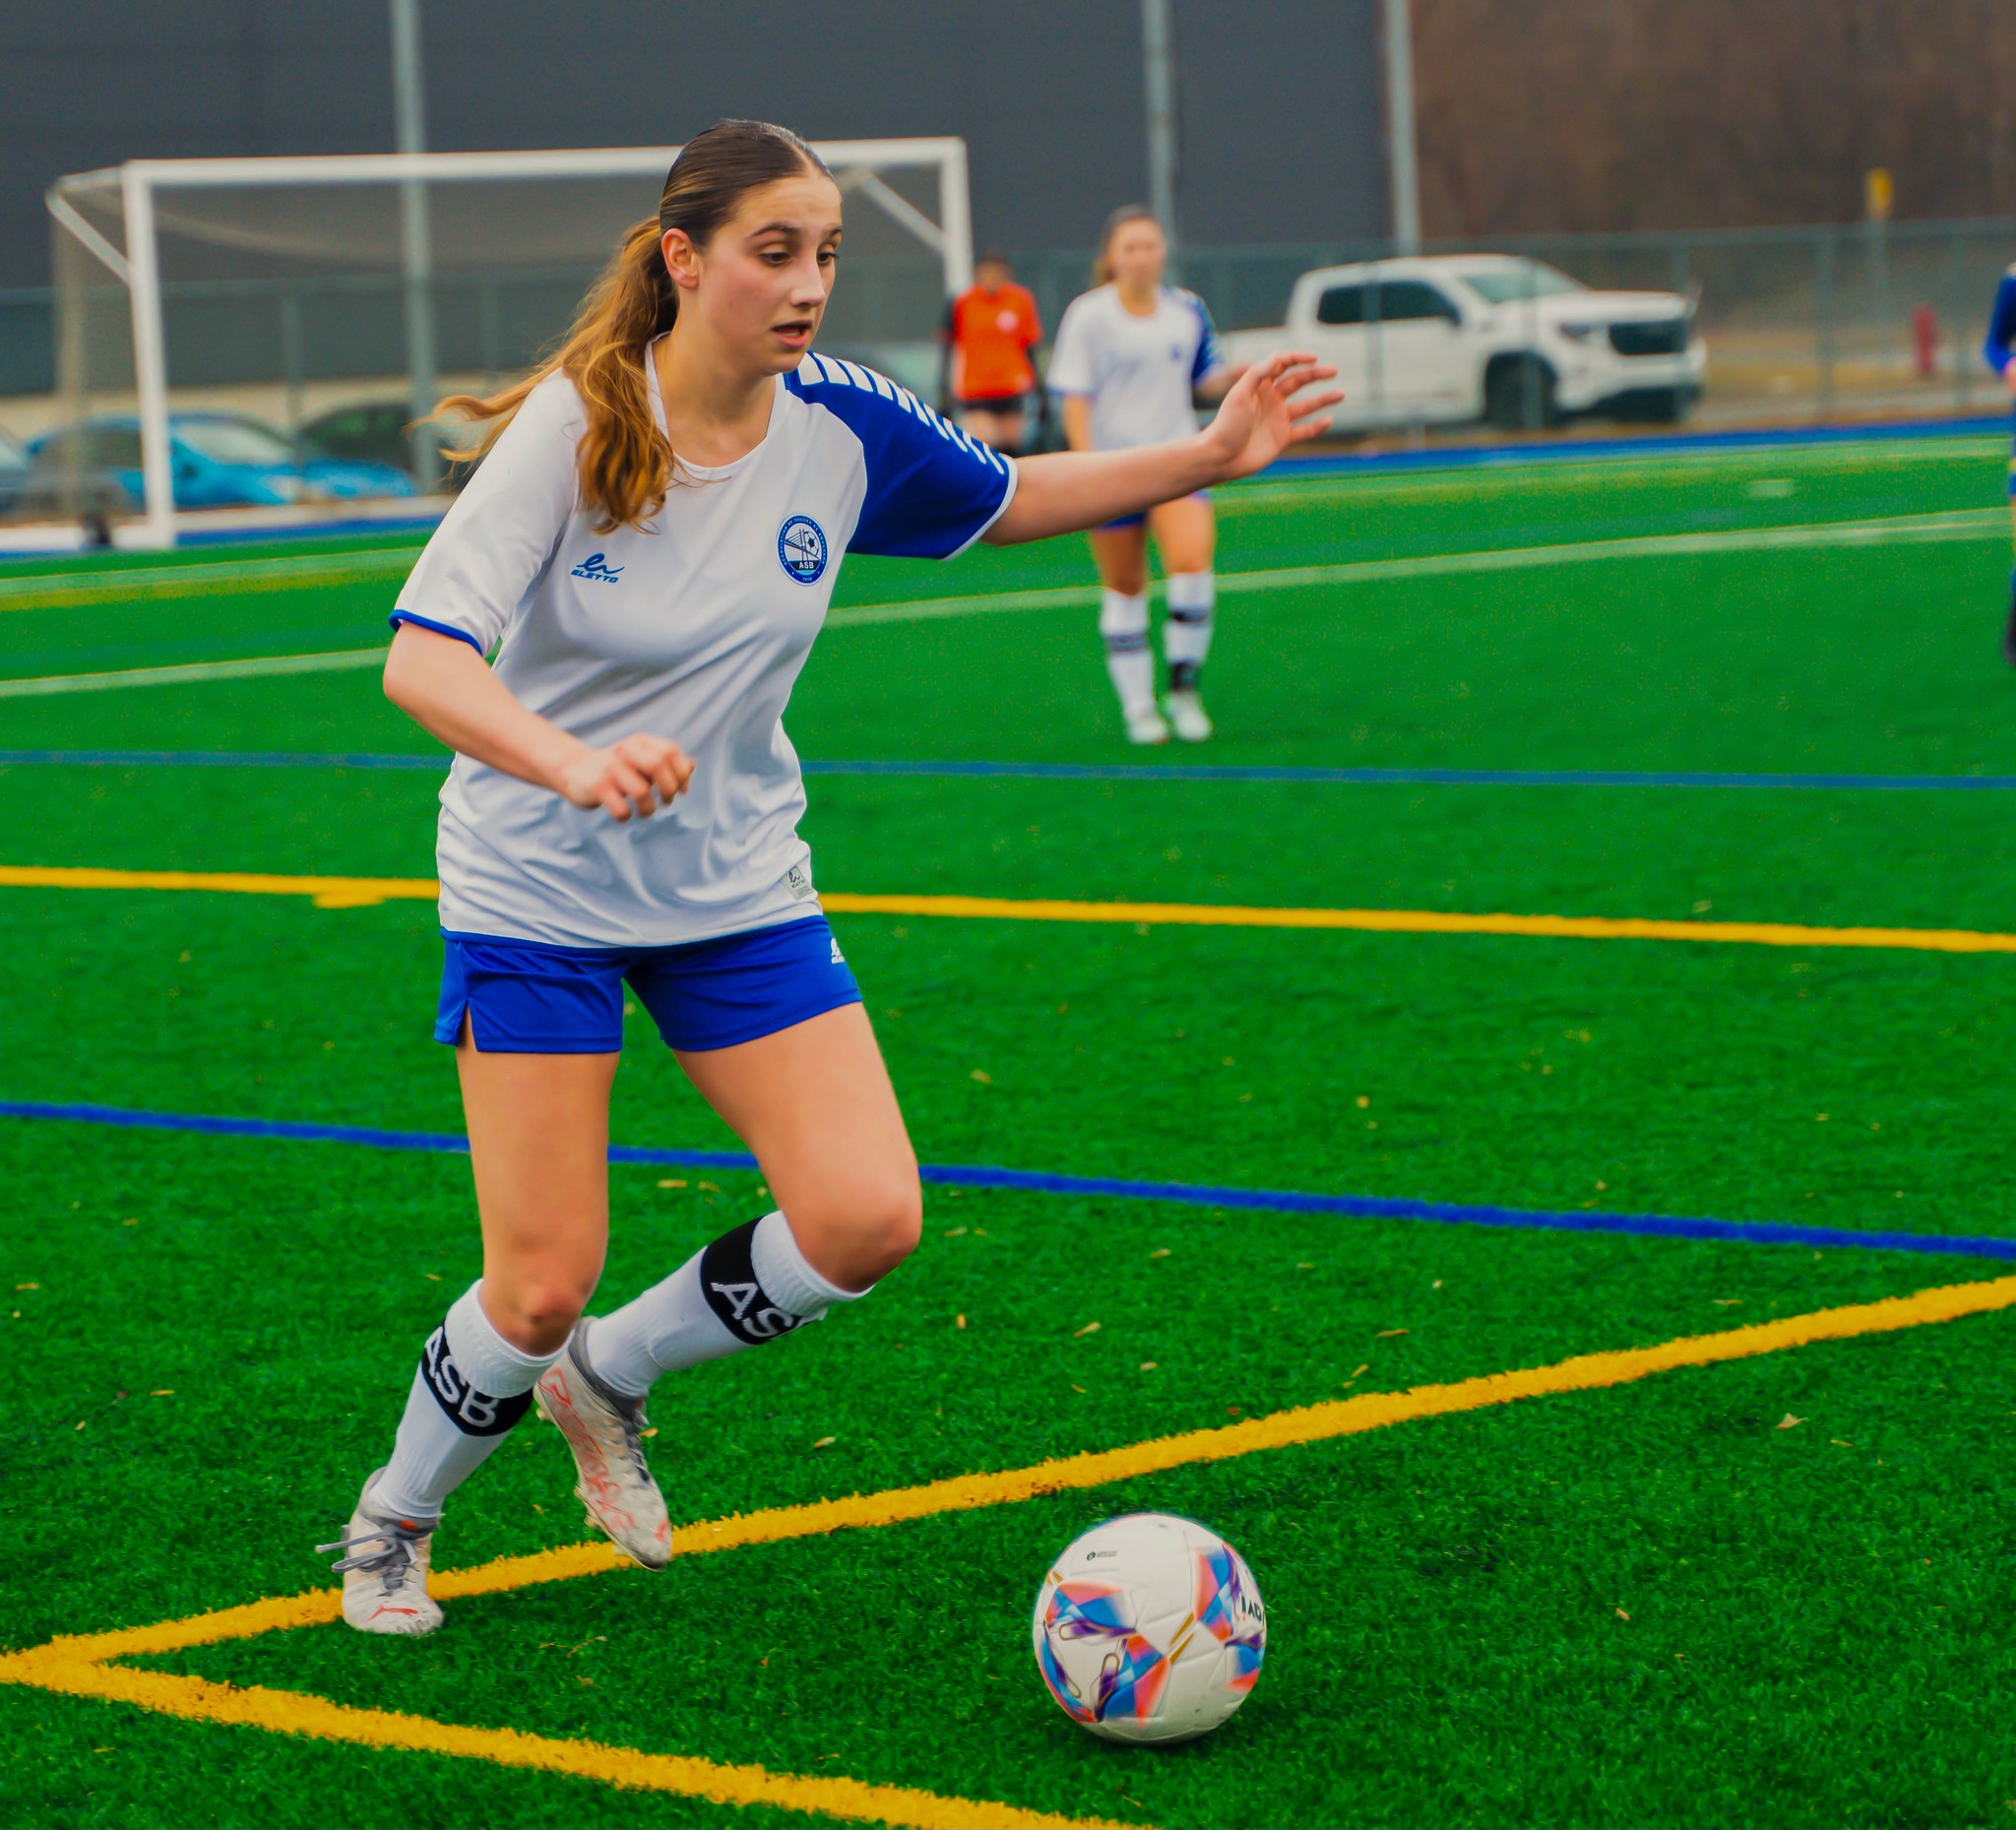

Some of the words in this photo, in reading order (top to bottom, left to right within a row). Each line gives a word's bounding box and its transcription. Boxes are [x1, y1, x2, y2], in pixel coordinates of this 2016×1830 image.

[570, 569, 619, 584] ELETTO
[799, 561, 814, 570] ASB
[710, 1282, 793, 1338] AS
[424, 1325, 496, 1428] ASB
